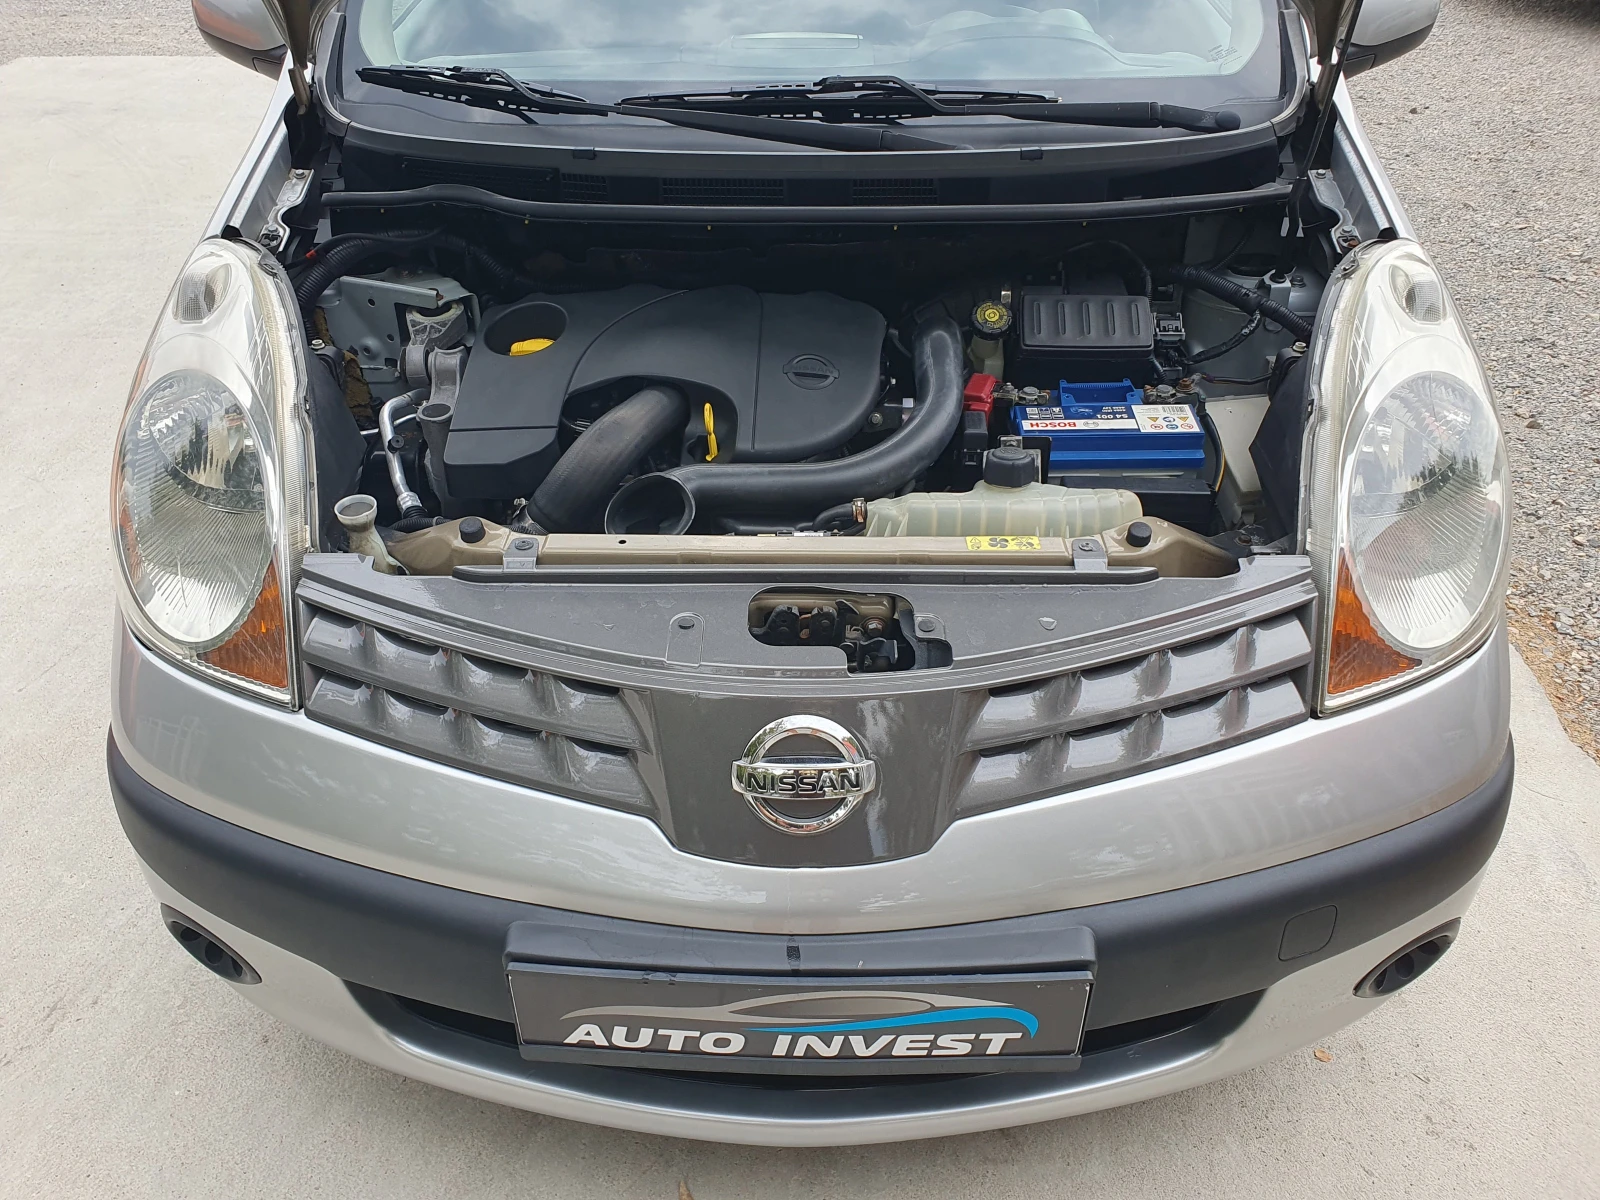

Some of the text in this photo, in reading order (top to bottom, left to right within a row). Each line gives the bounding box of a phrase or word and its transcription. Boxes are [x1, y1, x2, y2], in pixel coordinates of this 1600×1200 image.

[792, 364, 834, 374] NISSAN
[746, 772, 862, 794] NISSAN
[562, 1023, 1023, 1057] AUTO INVEST
